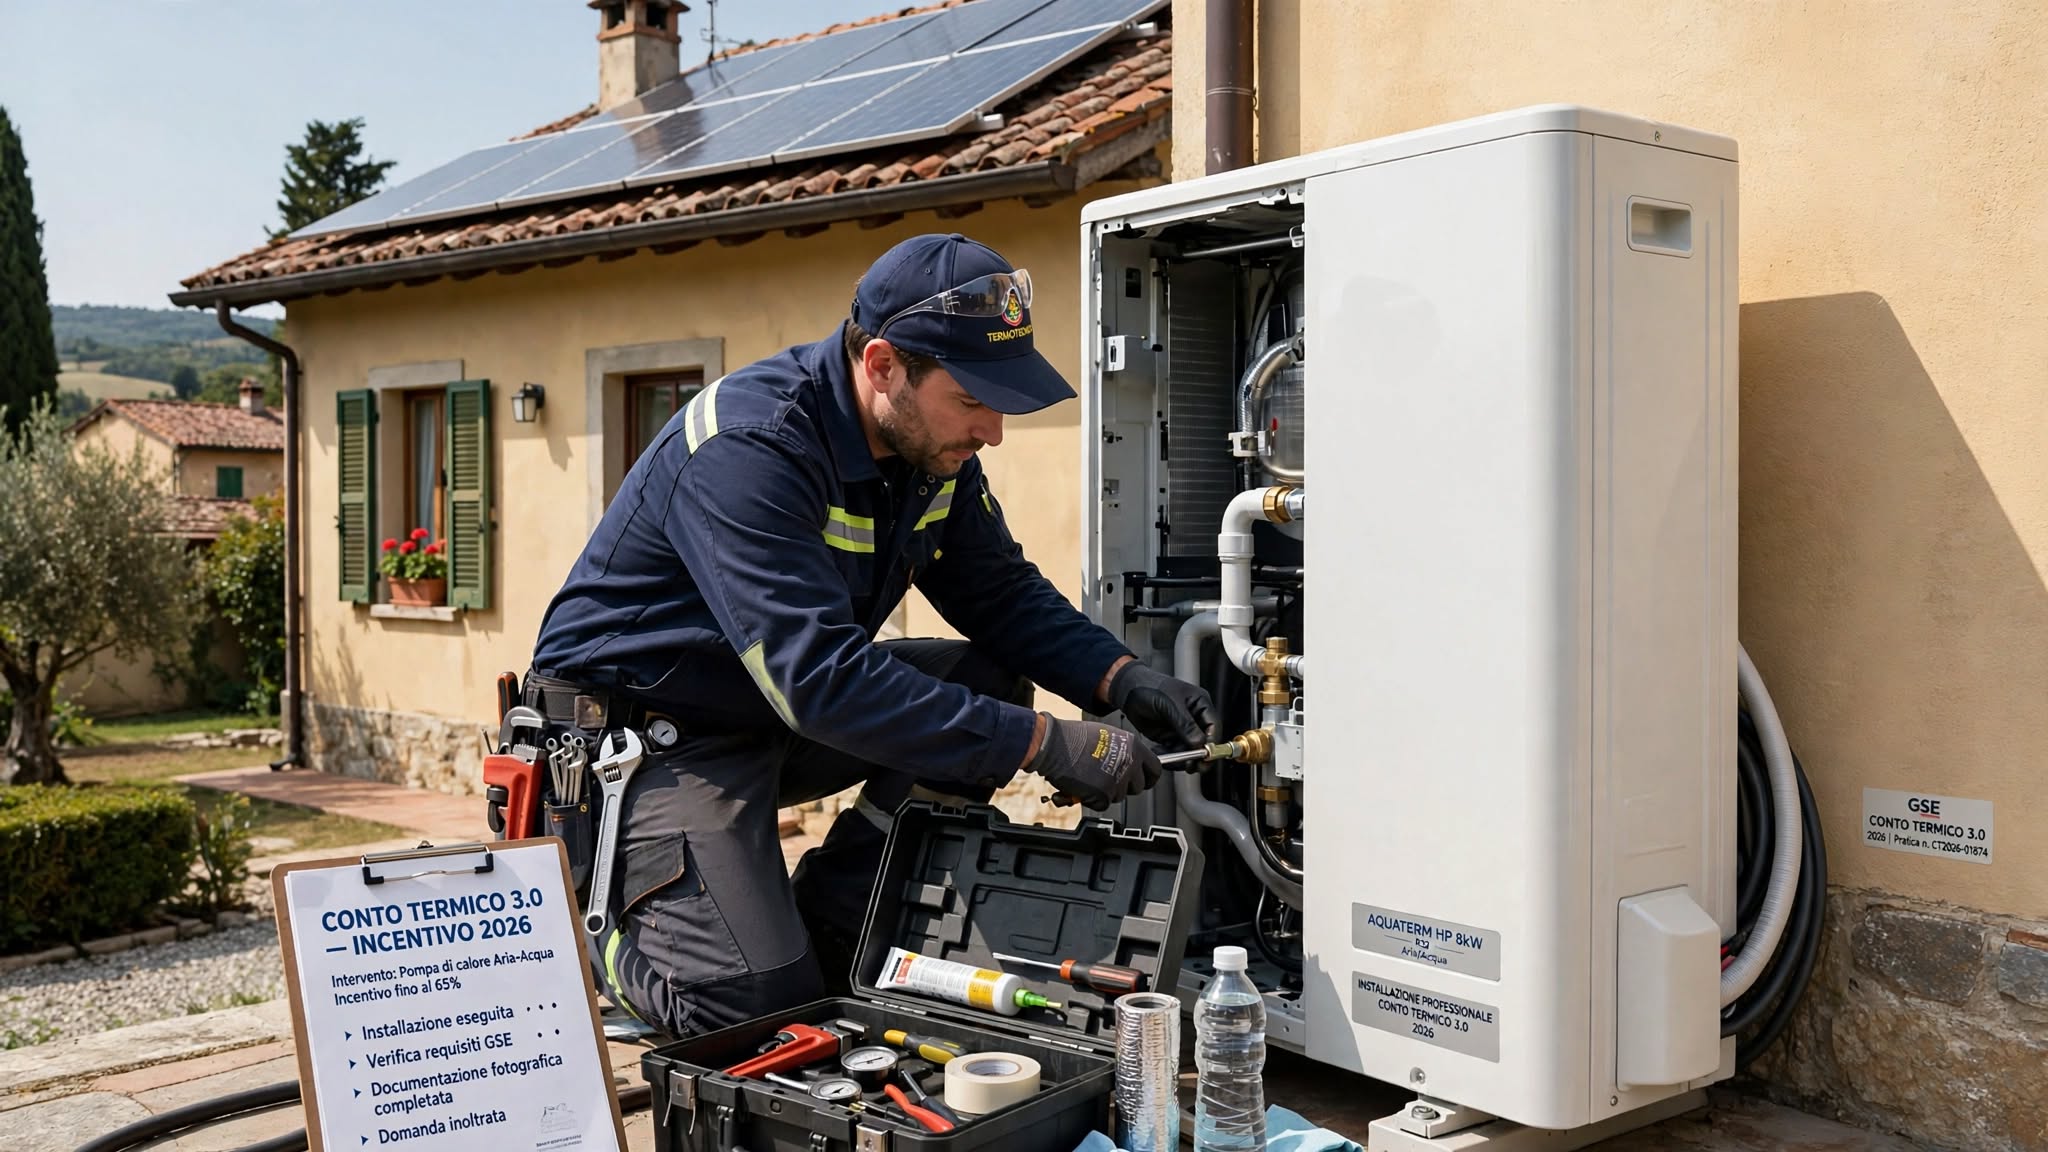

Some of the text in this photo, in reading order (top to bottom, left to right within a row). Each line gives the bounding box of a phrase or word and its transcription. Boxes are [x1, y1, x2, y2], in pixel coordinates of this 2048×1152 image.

[1908, 798, 1940, 814] GSE
[1867, 831, 1886, 841] 2026
[1894, 834, 1919, 847] Pratica
[1932, 841, 1988, 856] CT2026-01874
[1870, 815, 1985, 840] CONTO TERMICO 3.0
[322, 888, 543, 932] CONTO TERMICO 3.0
[352, 923, 474, 955] INCENTIVO
[481, 915, 532, 940] 2026
[1368, 914, 1482, 949] AQUATERM HP 8kW
[332, 949, 553, 987] Intervento: Pompa di calore Aria-Acqua
[335, 978, 461, 1005] Incentivo fino al 65%
[1358, 979, 1492, 1023] INSTALLAZIONE PROFESSIONALE
[363, 1006, 514, 1040] Installazione eseguita
[1378, 999, 1468, 1032] CONTO TERMICO 3.0
[1412, 1023, 1434, 1038] 2026
[366, 1033, 512, 1068] Verifica requisiti GSE
[371, 1054, 562, 1097] Documentazione fotografica
[374, 1092, 453, 1120] completata
[379, 1109, 506, 1144] Domanda inoltrata
